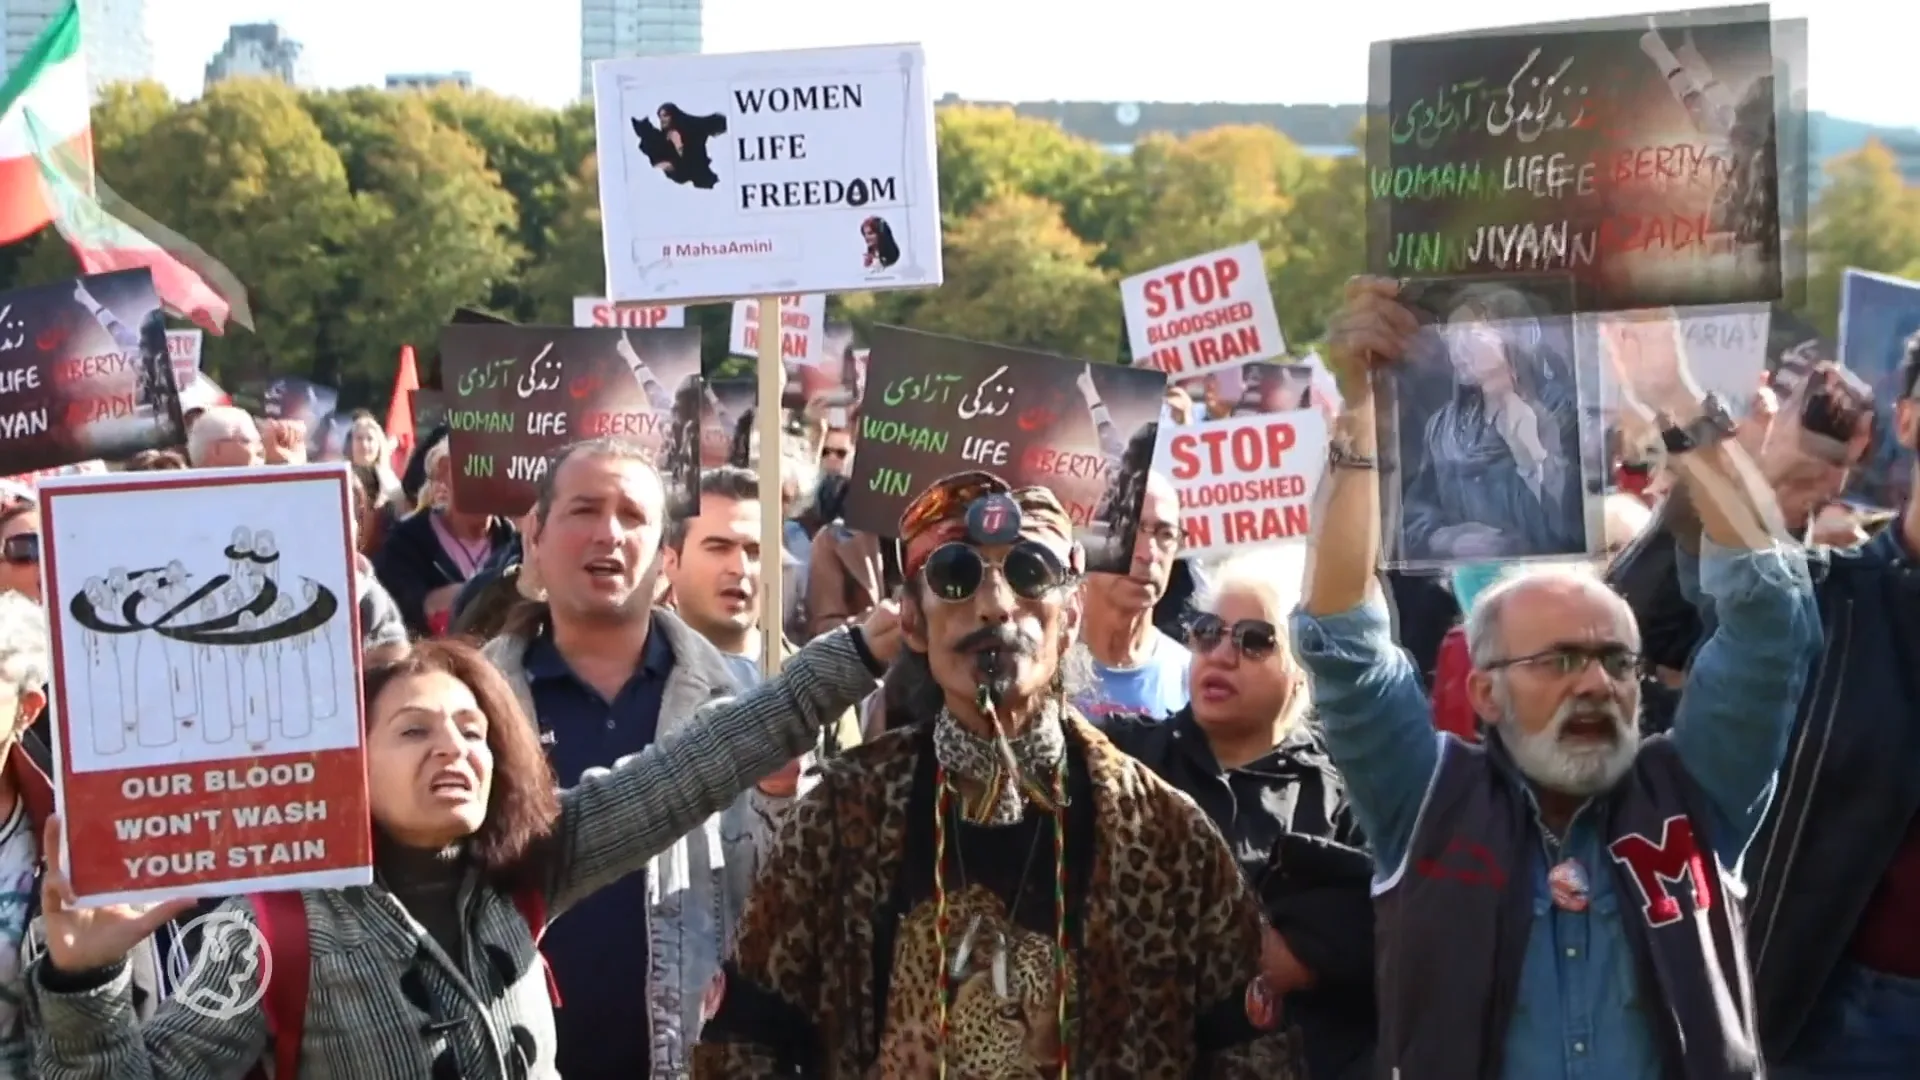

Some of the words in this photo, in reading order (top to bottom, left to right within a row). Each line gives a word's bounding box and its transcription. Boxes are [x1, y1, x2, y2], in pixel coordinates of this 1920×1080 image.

[733, 84, 864, 115] WOMEN
[737, 134, 808, 162] LIFE
[740, 176, 897, 208] FREEDOM
[662, 245, 672, 257] #
[675, 238, 773, 258] MahsaAmini
[1388, 231, 1442, 271] JIN
[1143, 258, 1239, 318] STOP
[1147, 301, 1253, 346] BLOODSHED
[1152, 346, 1183, 375] IN
[1190, 325, 1261, 367] IRAN
[0, 366, 40, 394] LIFE
[448, 409, 515, 433] WOMAN
[527, 411, 566, 436] LIFE
[581, 412, 658, 436] BERTY
[863, 416, 949, 454] WOMAN
[962, 436, 1009, 465] LIFE
[1022, 444, 1107, 479] BERTY
[1171, 424, 1296, 480] STOP
[464, 454, 493, 477] JIN
[507, 455, 550, 482] JIYA
[869, 467, 912, 496] JIN
[1222, 504, 1309, 544] IRAN
[122, 774, 192, 800] OUR
[205, 761, 315, 791] BLOOD
[115, 809, 221, 840] WON'T
[233, 800, 327, 828] WASH
[124, 854, 215, 879] YOUR
[227, 839, 325, 869] STAIN
[1609, 815, 1711, 928] M
